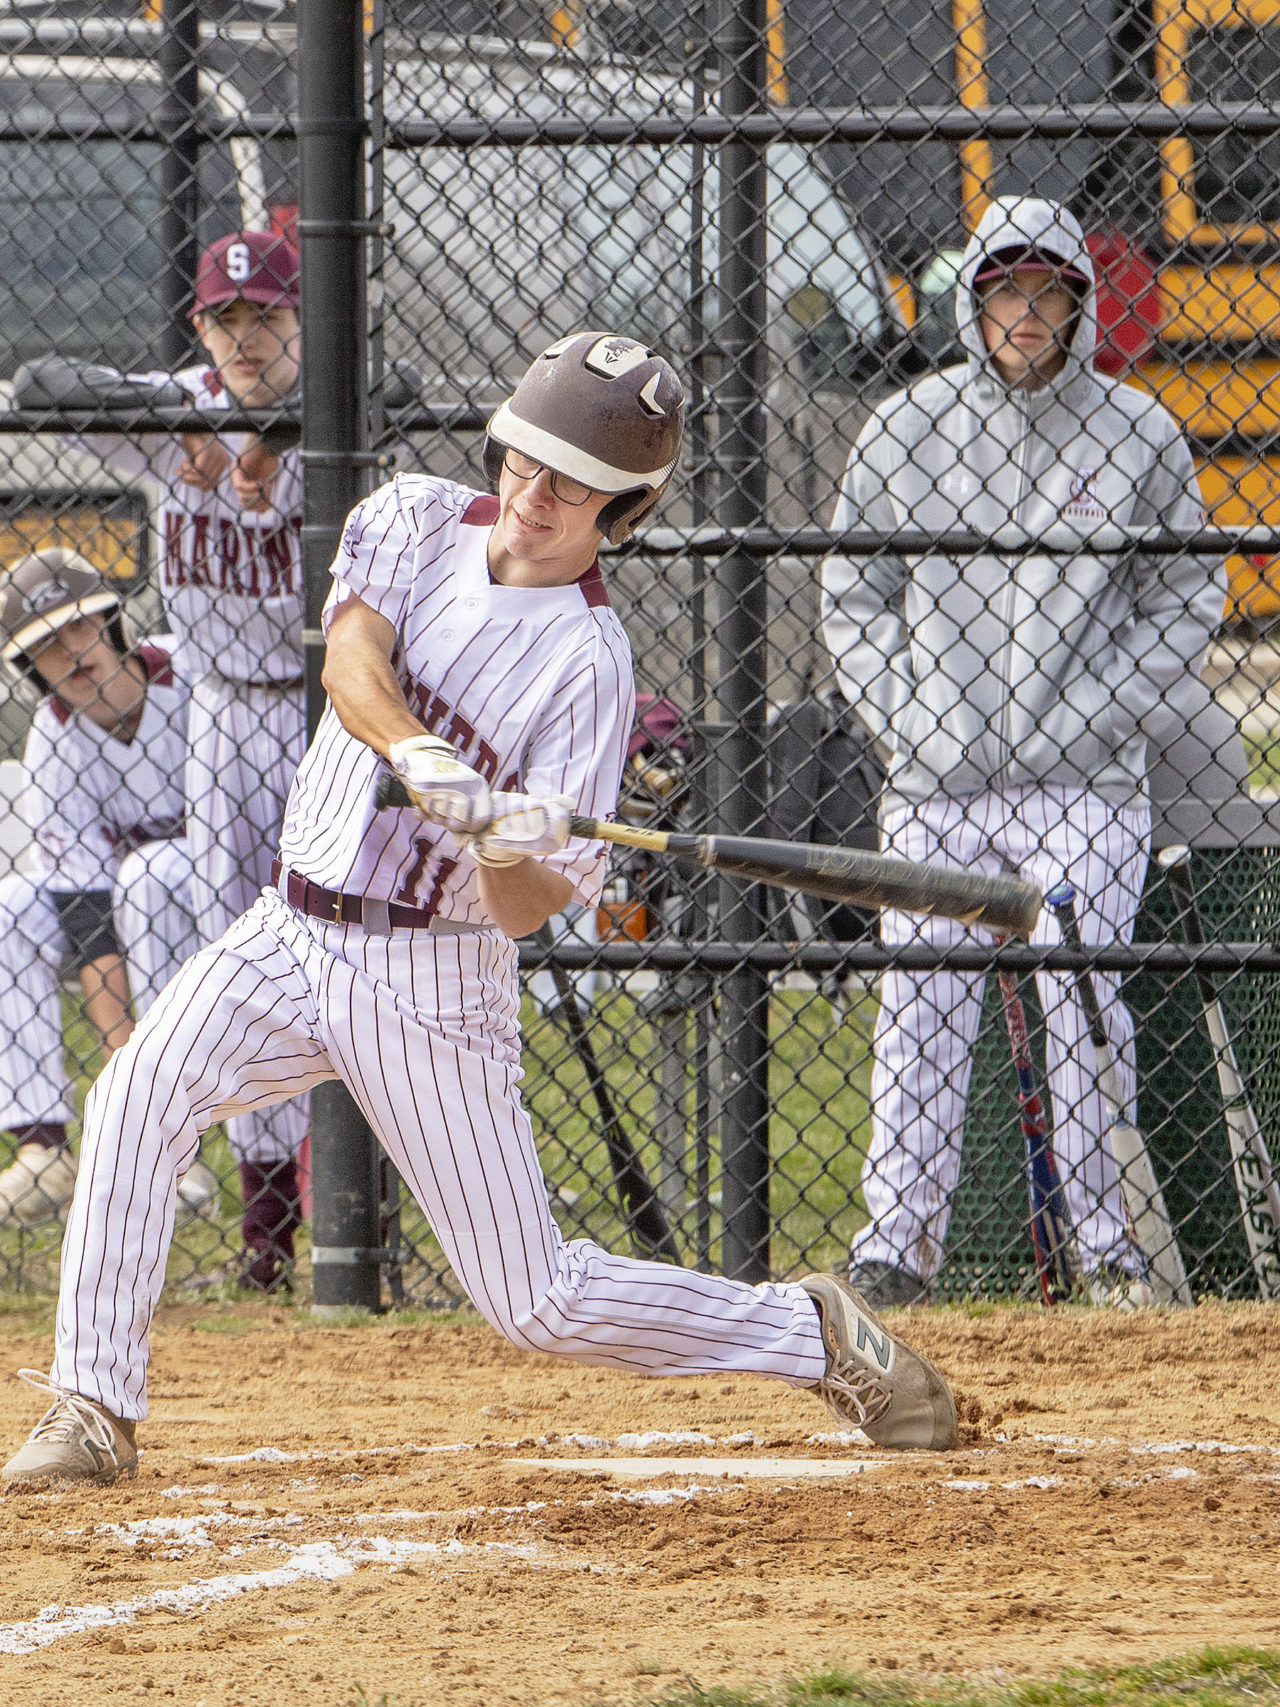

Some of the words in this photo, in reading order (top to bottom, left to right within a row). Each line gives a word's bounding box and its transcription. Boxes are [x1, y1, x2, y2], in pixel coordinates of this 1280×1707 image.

[227, 243, 250, 280] S
[165, 512, 303, 598] MARIN
[395, 836, 458, 915] 11
[856, 1316, 891, 1370] N
